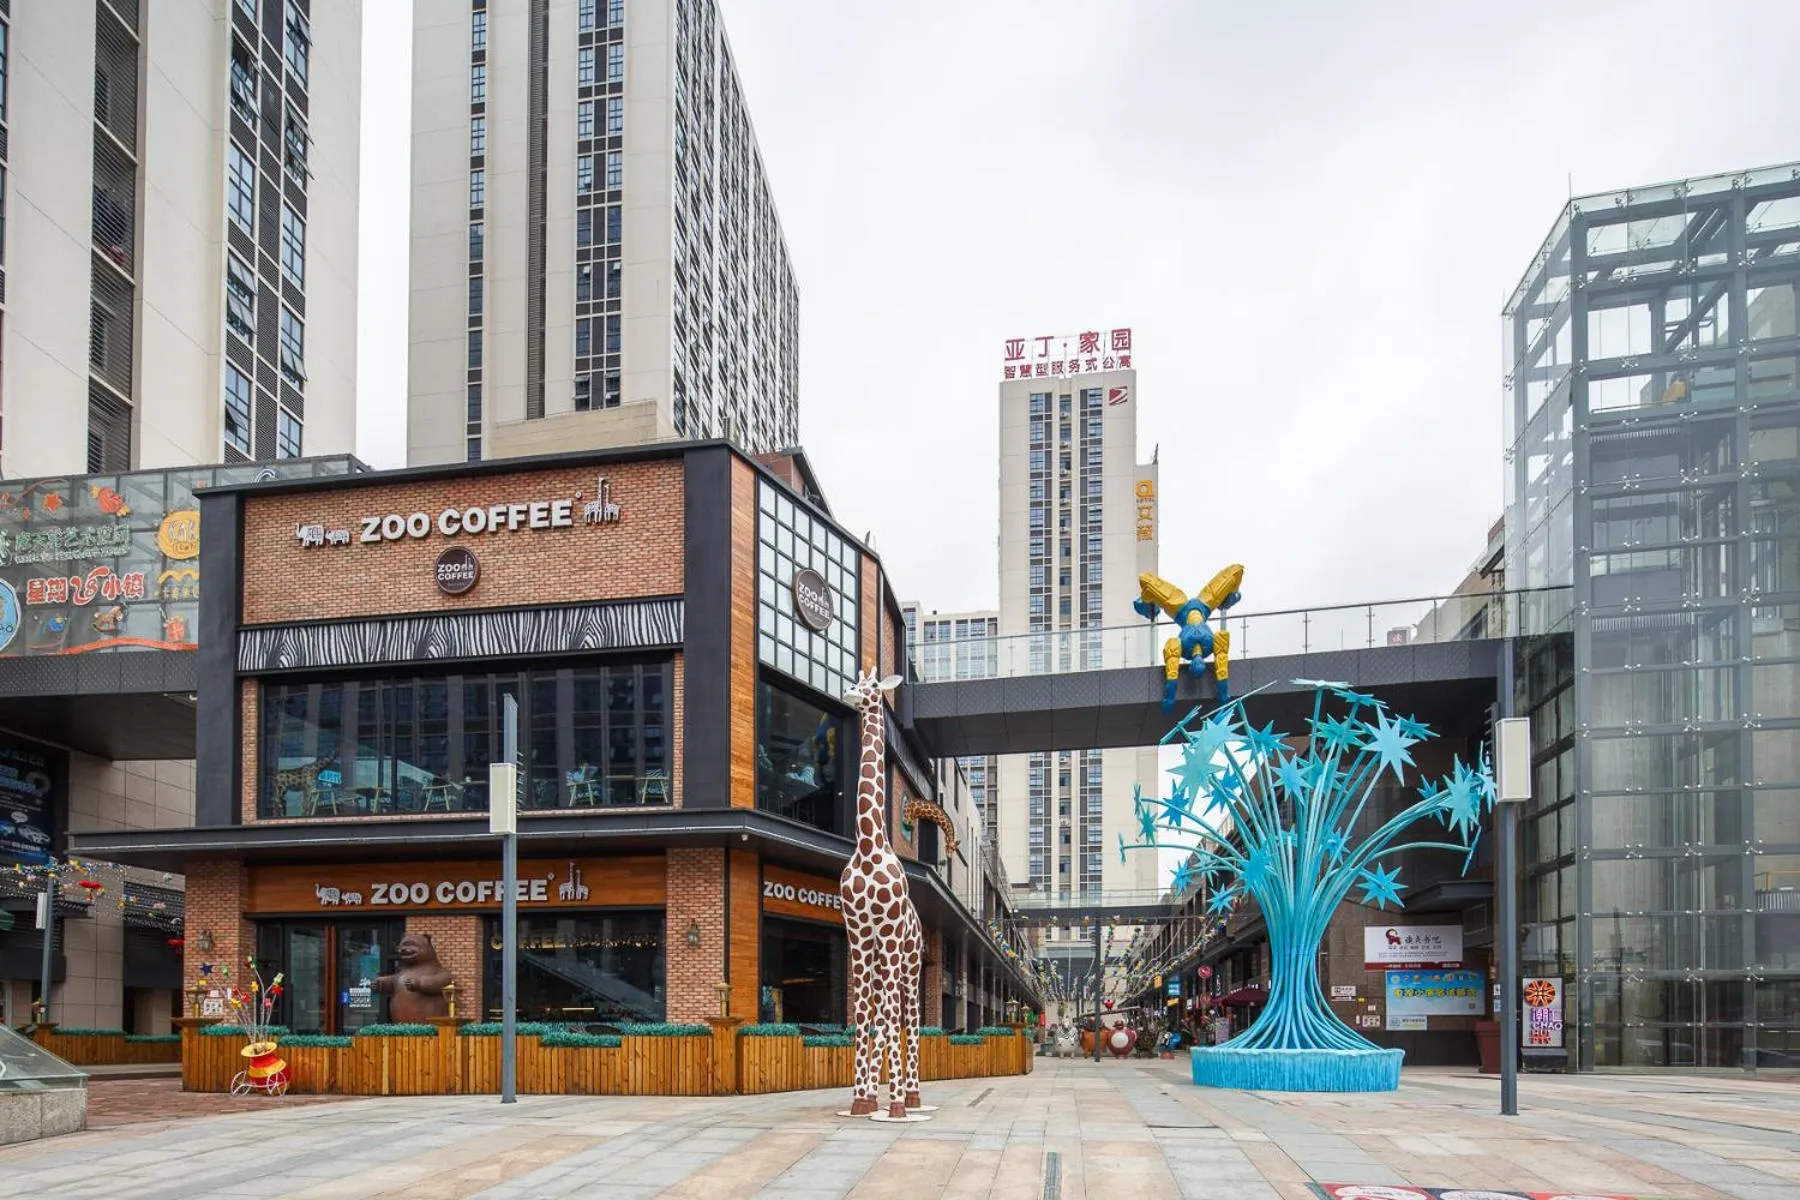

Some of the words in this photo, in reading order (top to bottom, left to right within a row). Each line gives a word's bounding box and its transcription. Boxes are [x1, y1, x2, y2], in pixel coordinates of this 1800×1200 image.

[1004, 328, 1132, 362] 亚丁·家园
[1004, 355, 1132, 379] 智慧型服务式公寓
[360, 512, 430, 543] ZOO
[438, 500, 573, 536] COFFEE
[437, 571, 474, 581] COFFEE
[438, 563, 460, 573] ZOO
[798, 582, 818, 602] ZOO
[798, 594, 830, 621] COFFEE
[370, 882, 430, 904] ZOO
[763, 881, 795, 901] ZOO
[797, 888, 841, 910] COFFE
